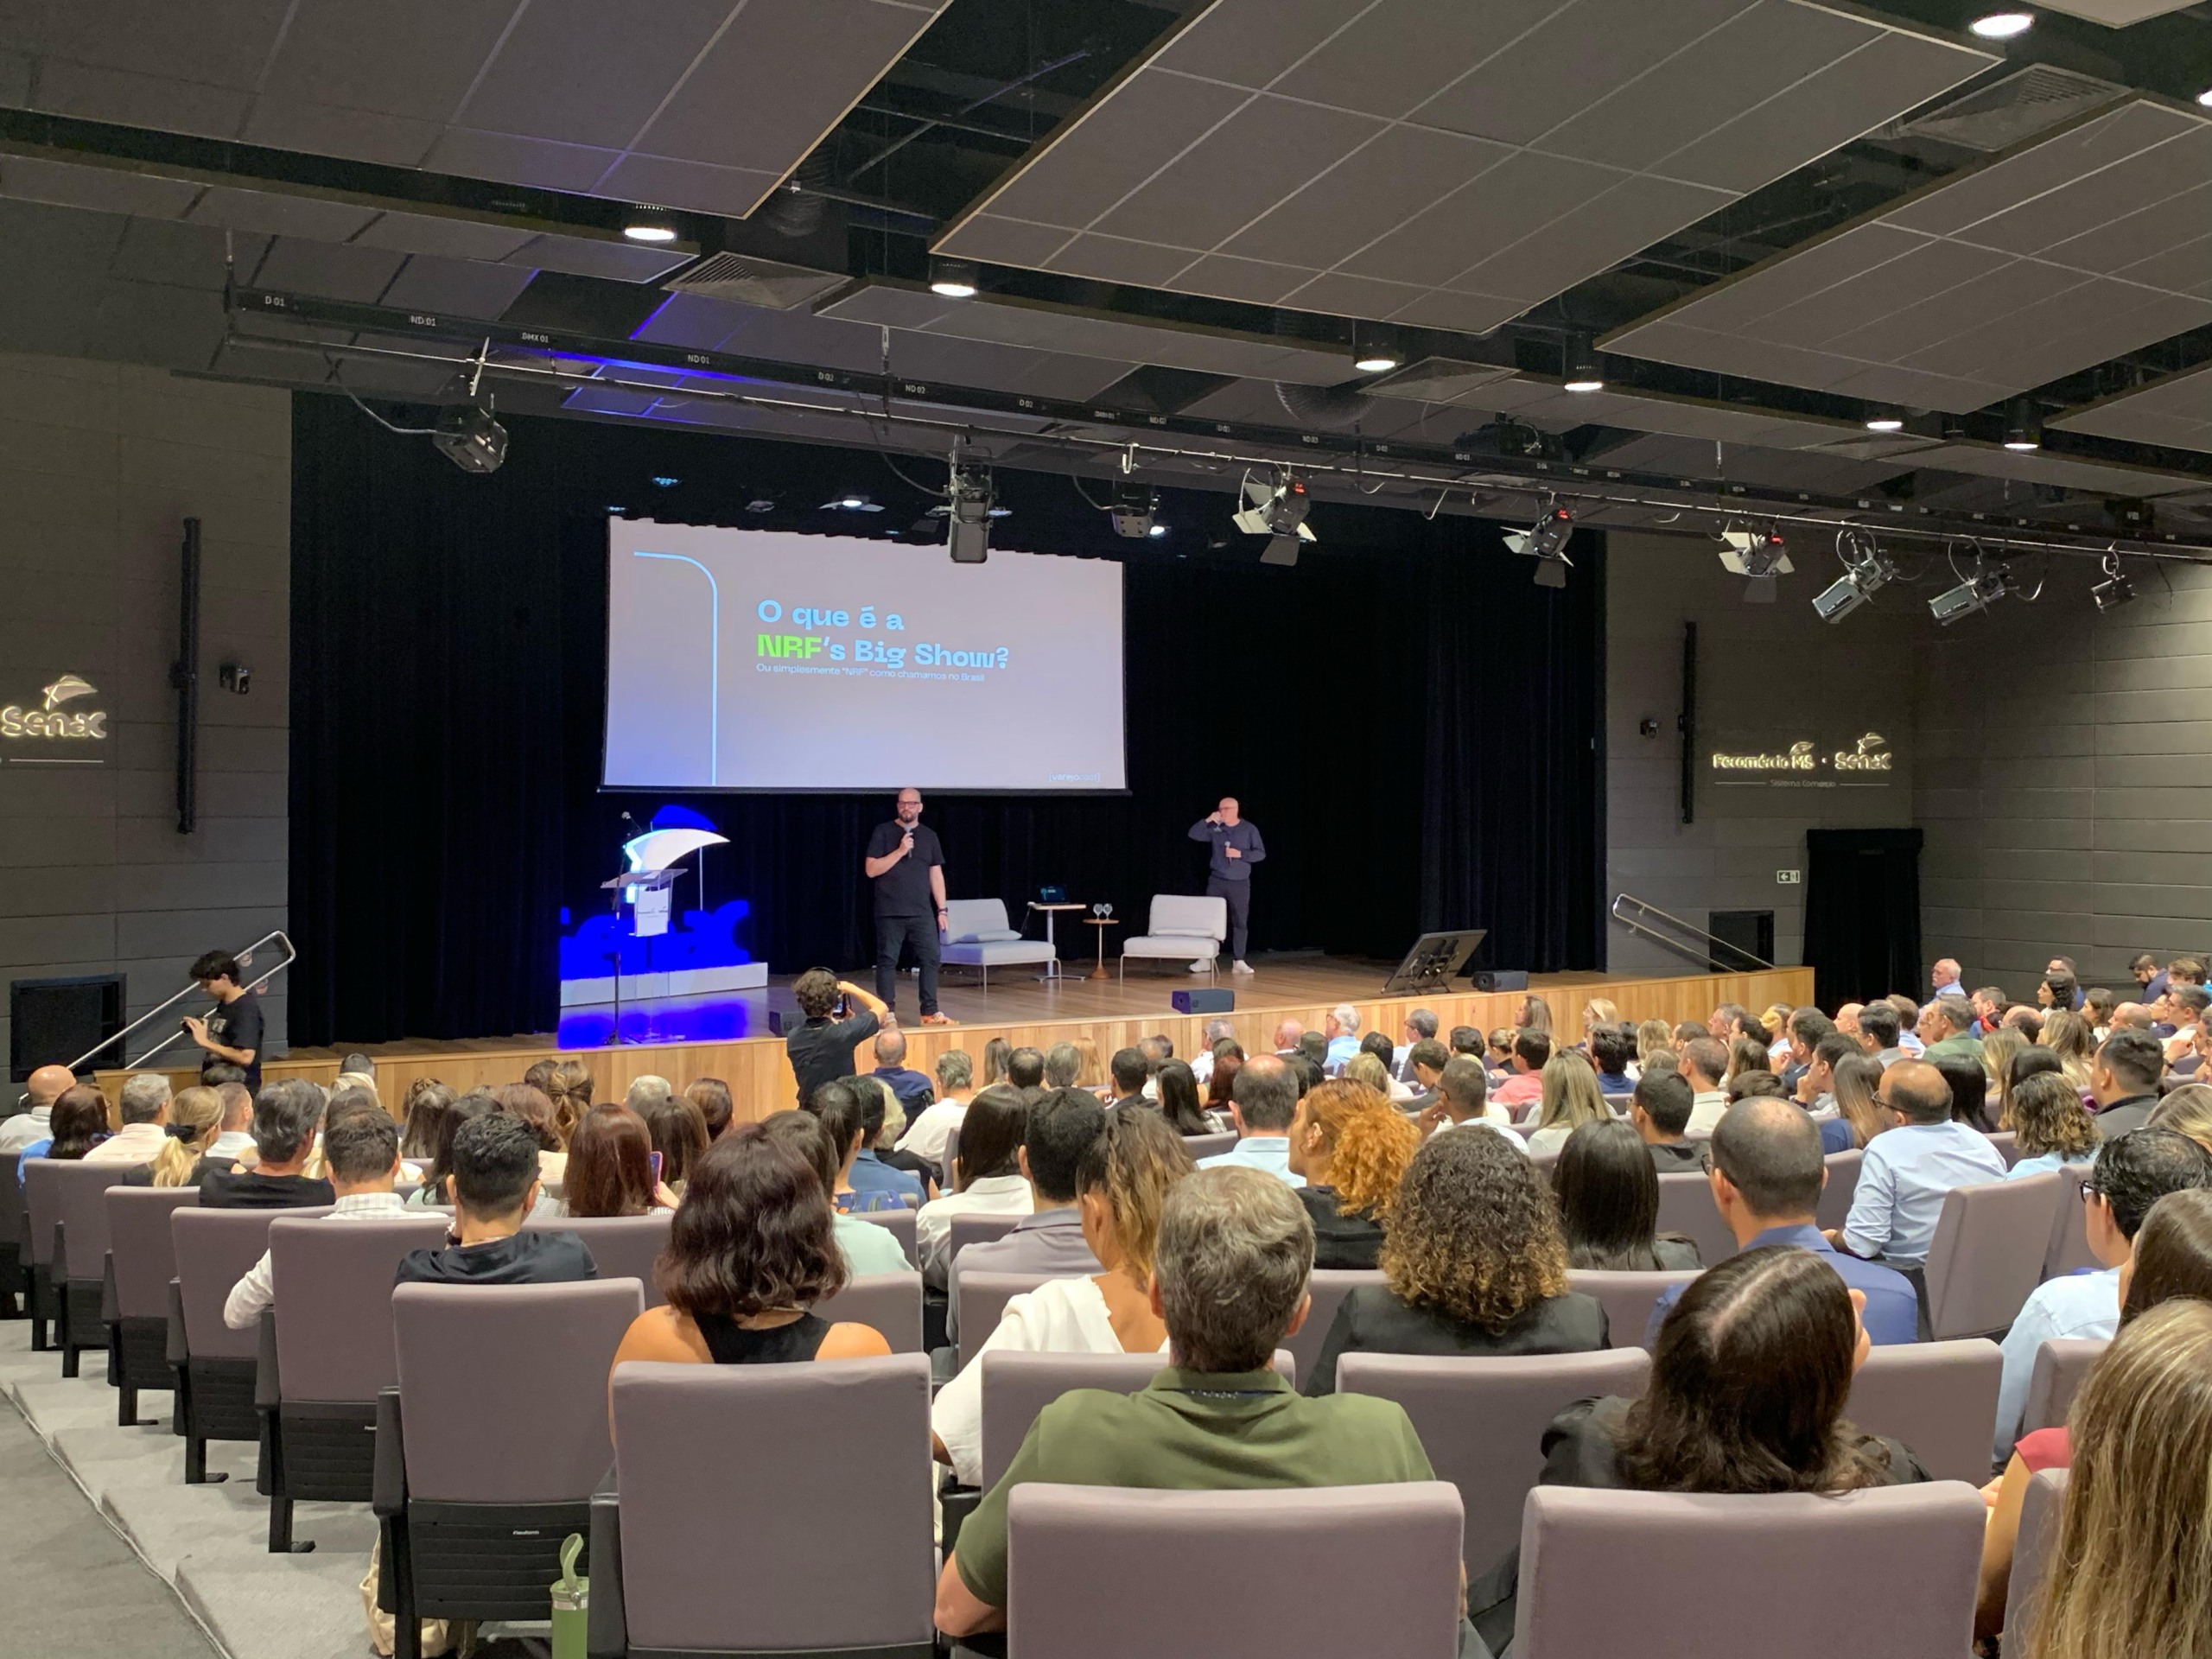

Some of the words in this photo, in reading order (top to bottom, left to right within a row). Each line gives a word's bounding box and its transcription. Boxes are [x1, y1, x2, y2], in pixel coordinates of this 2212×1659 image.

[264, 296, 272, 304] D
[273, 297, 285, 307] 01
[426, 317, 436, 327] 01
[540, 334, 549, 343] 01
[687, 354, 699, 364] ND
[701, 355, 710, 365] 01
[817, 372, 824, 380] D
[906, 385, 916, 393] ND
[757, 599, 782, 623] O
[791, 607, 849, 630] que
[859, 606, 876, 628] é
[886, 613, 905, 630] a
[757, 633, 846, 661] NRF's
[855, 639, 906, 669] Big
[914, 643, 1009, 670] Show?
[756, 662, 772, 672] Ou
[772, 664, 841, 675] simplesmente
[869, 669, 896, 677] como
[897, 670, 946, 680] chamamos
[961, 672, 985, 682] Brasil
[2, 705, 107, 739] Senac
[1713, 753, 1789, 769] Fecomércio
[1791, 754, 1815, 769] MS
[1834, 751, 1891, 770] Senac
[1770, 779, 1801, 788] Sistema
